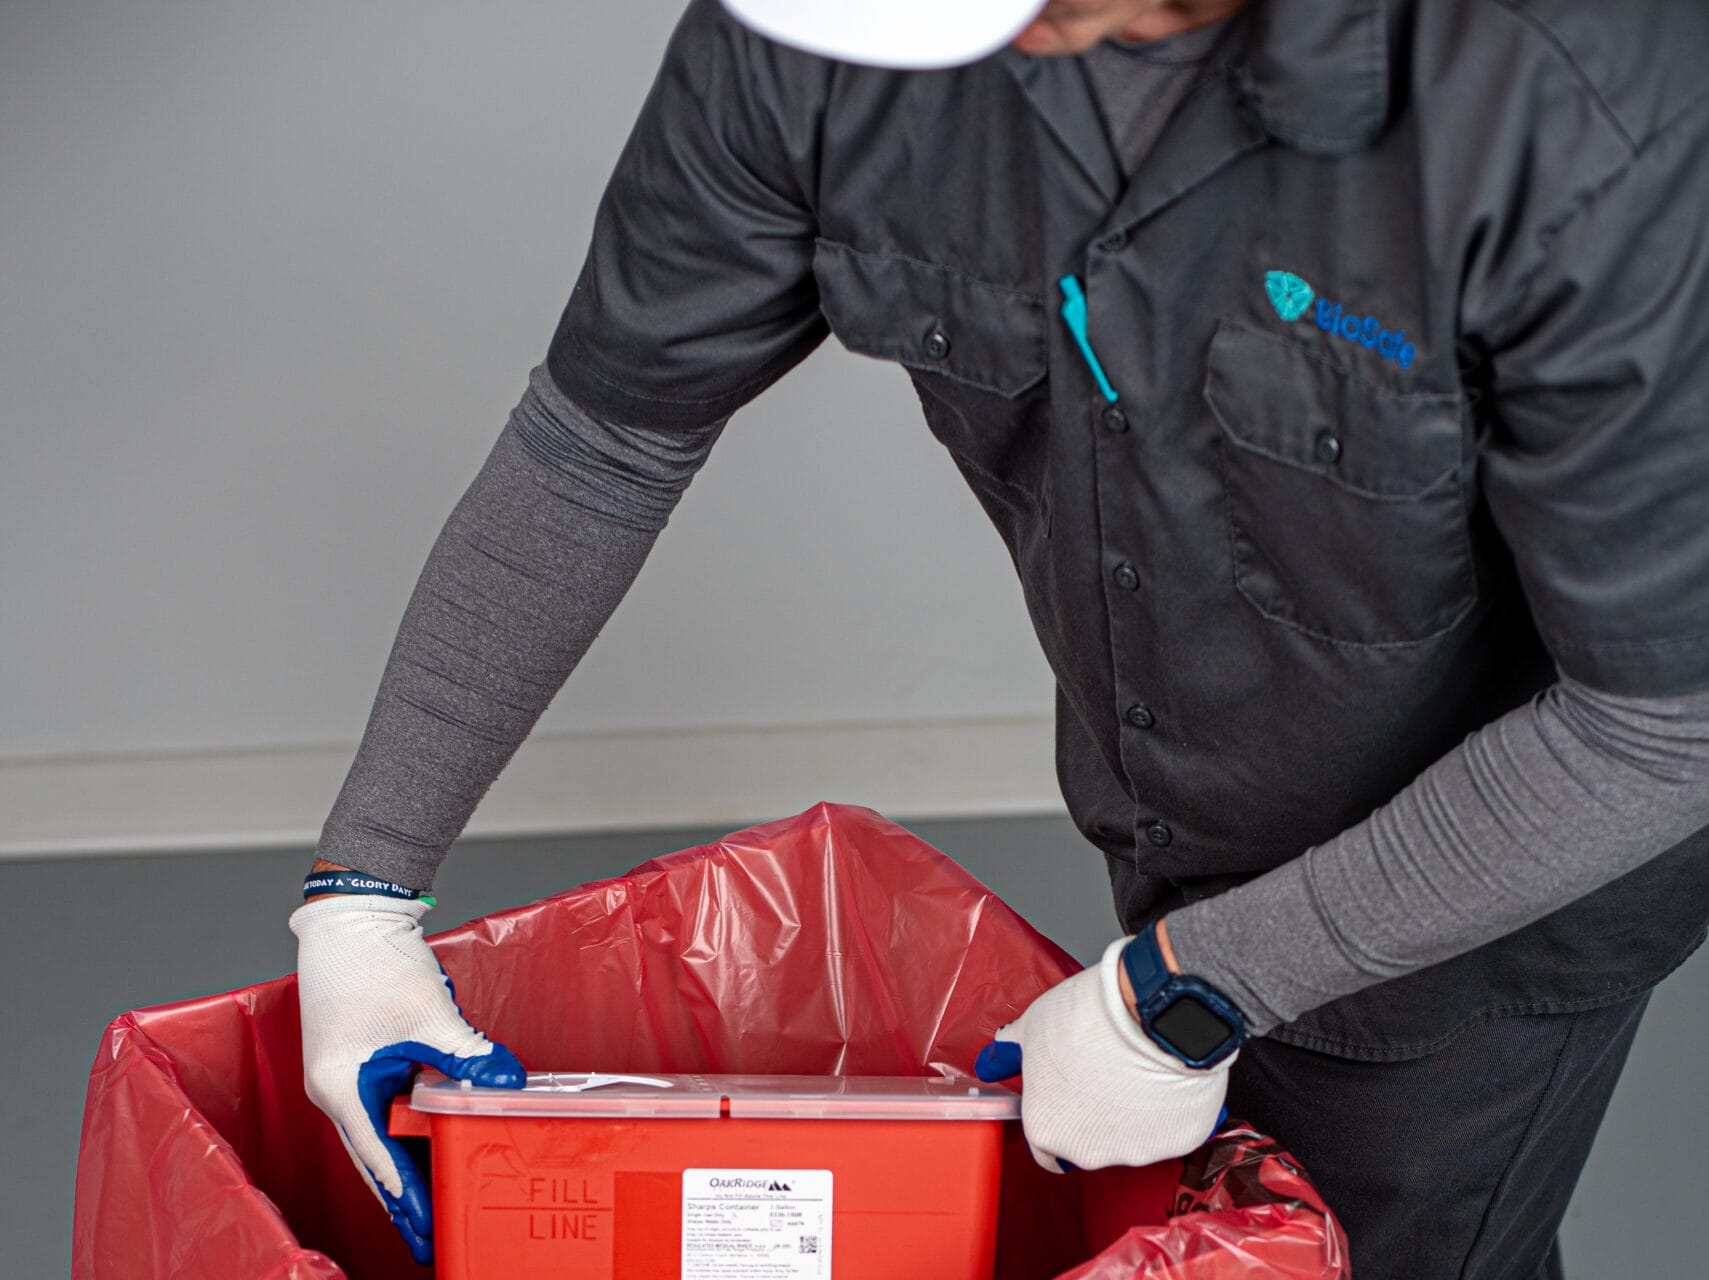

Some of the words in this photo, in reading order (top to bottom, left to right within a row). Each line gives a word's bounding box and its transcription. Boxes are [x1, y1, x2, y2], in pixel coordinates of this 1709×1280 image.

[309, 878, 334, 888] TODAY
[336, 878, 344, 886] A
[529, 1177, 599, 1205] FILL
[529, 1214, 598, 1241] LINE
